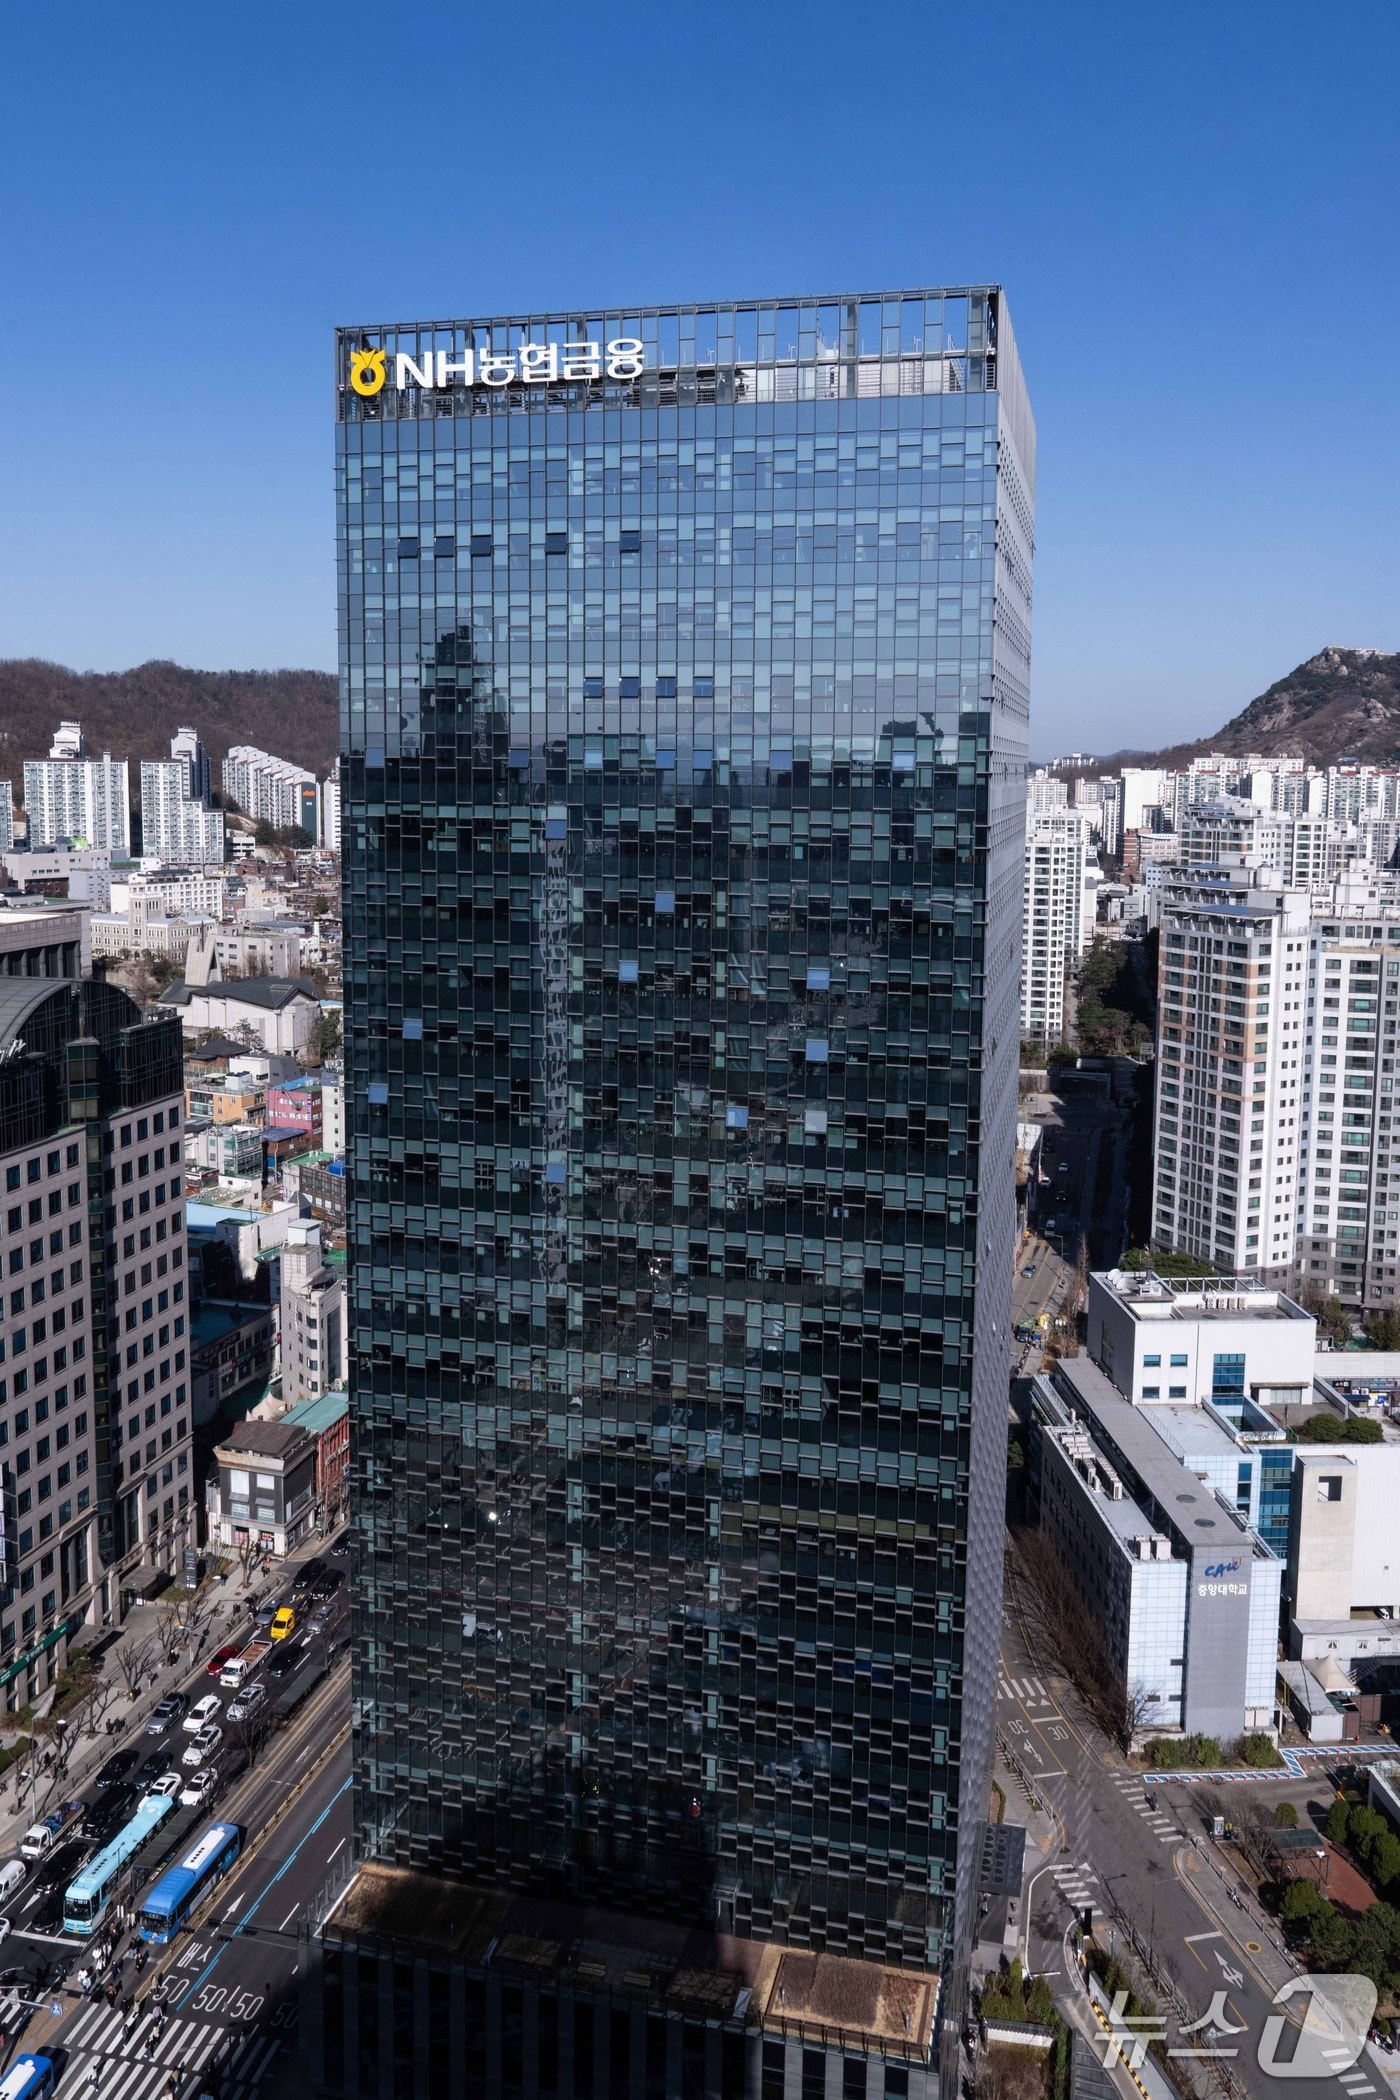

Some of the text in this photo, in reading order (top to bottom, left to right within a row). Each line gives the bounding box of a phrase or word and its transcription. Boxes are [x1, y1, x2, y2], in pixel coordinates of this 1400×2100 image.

[396, 338, 646, 390] NH농협금융
[1198, 1583, 1247, 1597] 중앙대학교
[1047, 1725, 1069, 1741] 30
[176, 1942, 213, 1971] 버스
[152, 1974, 190, 2004] 50
[192, 1984, 228, 2012] 50
[230, 1992, 265, 2020] 50
